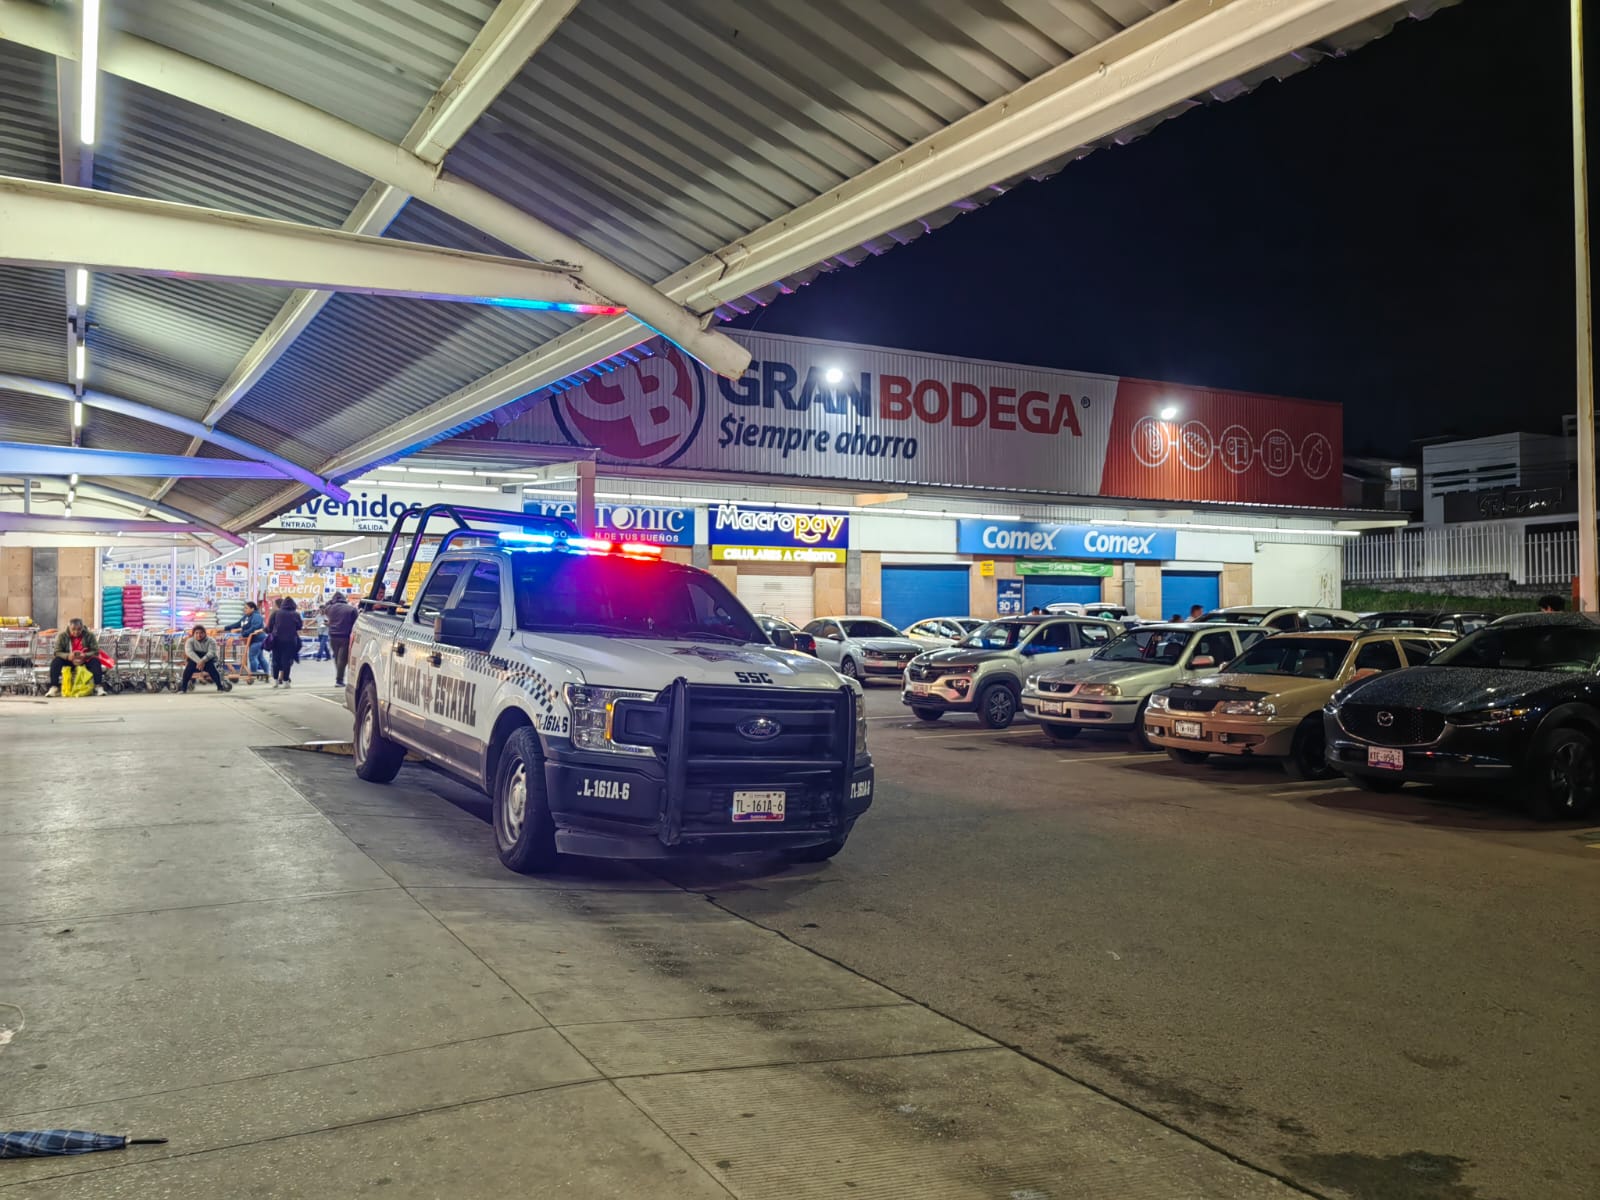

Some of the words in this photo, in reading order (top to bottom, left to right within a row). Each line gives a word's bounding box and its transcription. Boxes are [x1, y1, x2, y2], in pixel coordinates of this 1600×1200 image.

[718, 360, 871, 418] GRAN
[879, 373, 1082, 436] BODEGA
[835, 425, 918, 460] ahorro
[296, 492, 422, 519] venidos
[281, 521, 317, 529] ENTRADA
[716, 504, 844, 542] Macropay
[604, 532, 617, 541] DE
[619, 532, 638, 542] TUS
[640, 531, 679, 543] SUEÑOS
[983, 526, 1061, 551] Comex
[1084, 531, 1155, 554] Comex
[784, 551, 792, 560] A
[735, 671, 773, 684] SSC
[434, 674, 477, 728] ESTATAL
[577, 779, 630, 800] L-161A-6
[736, 799, 783, 813] TL-161A-6
